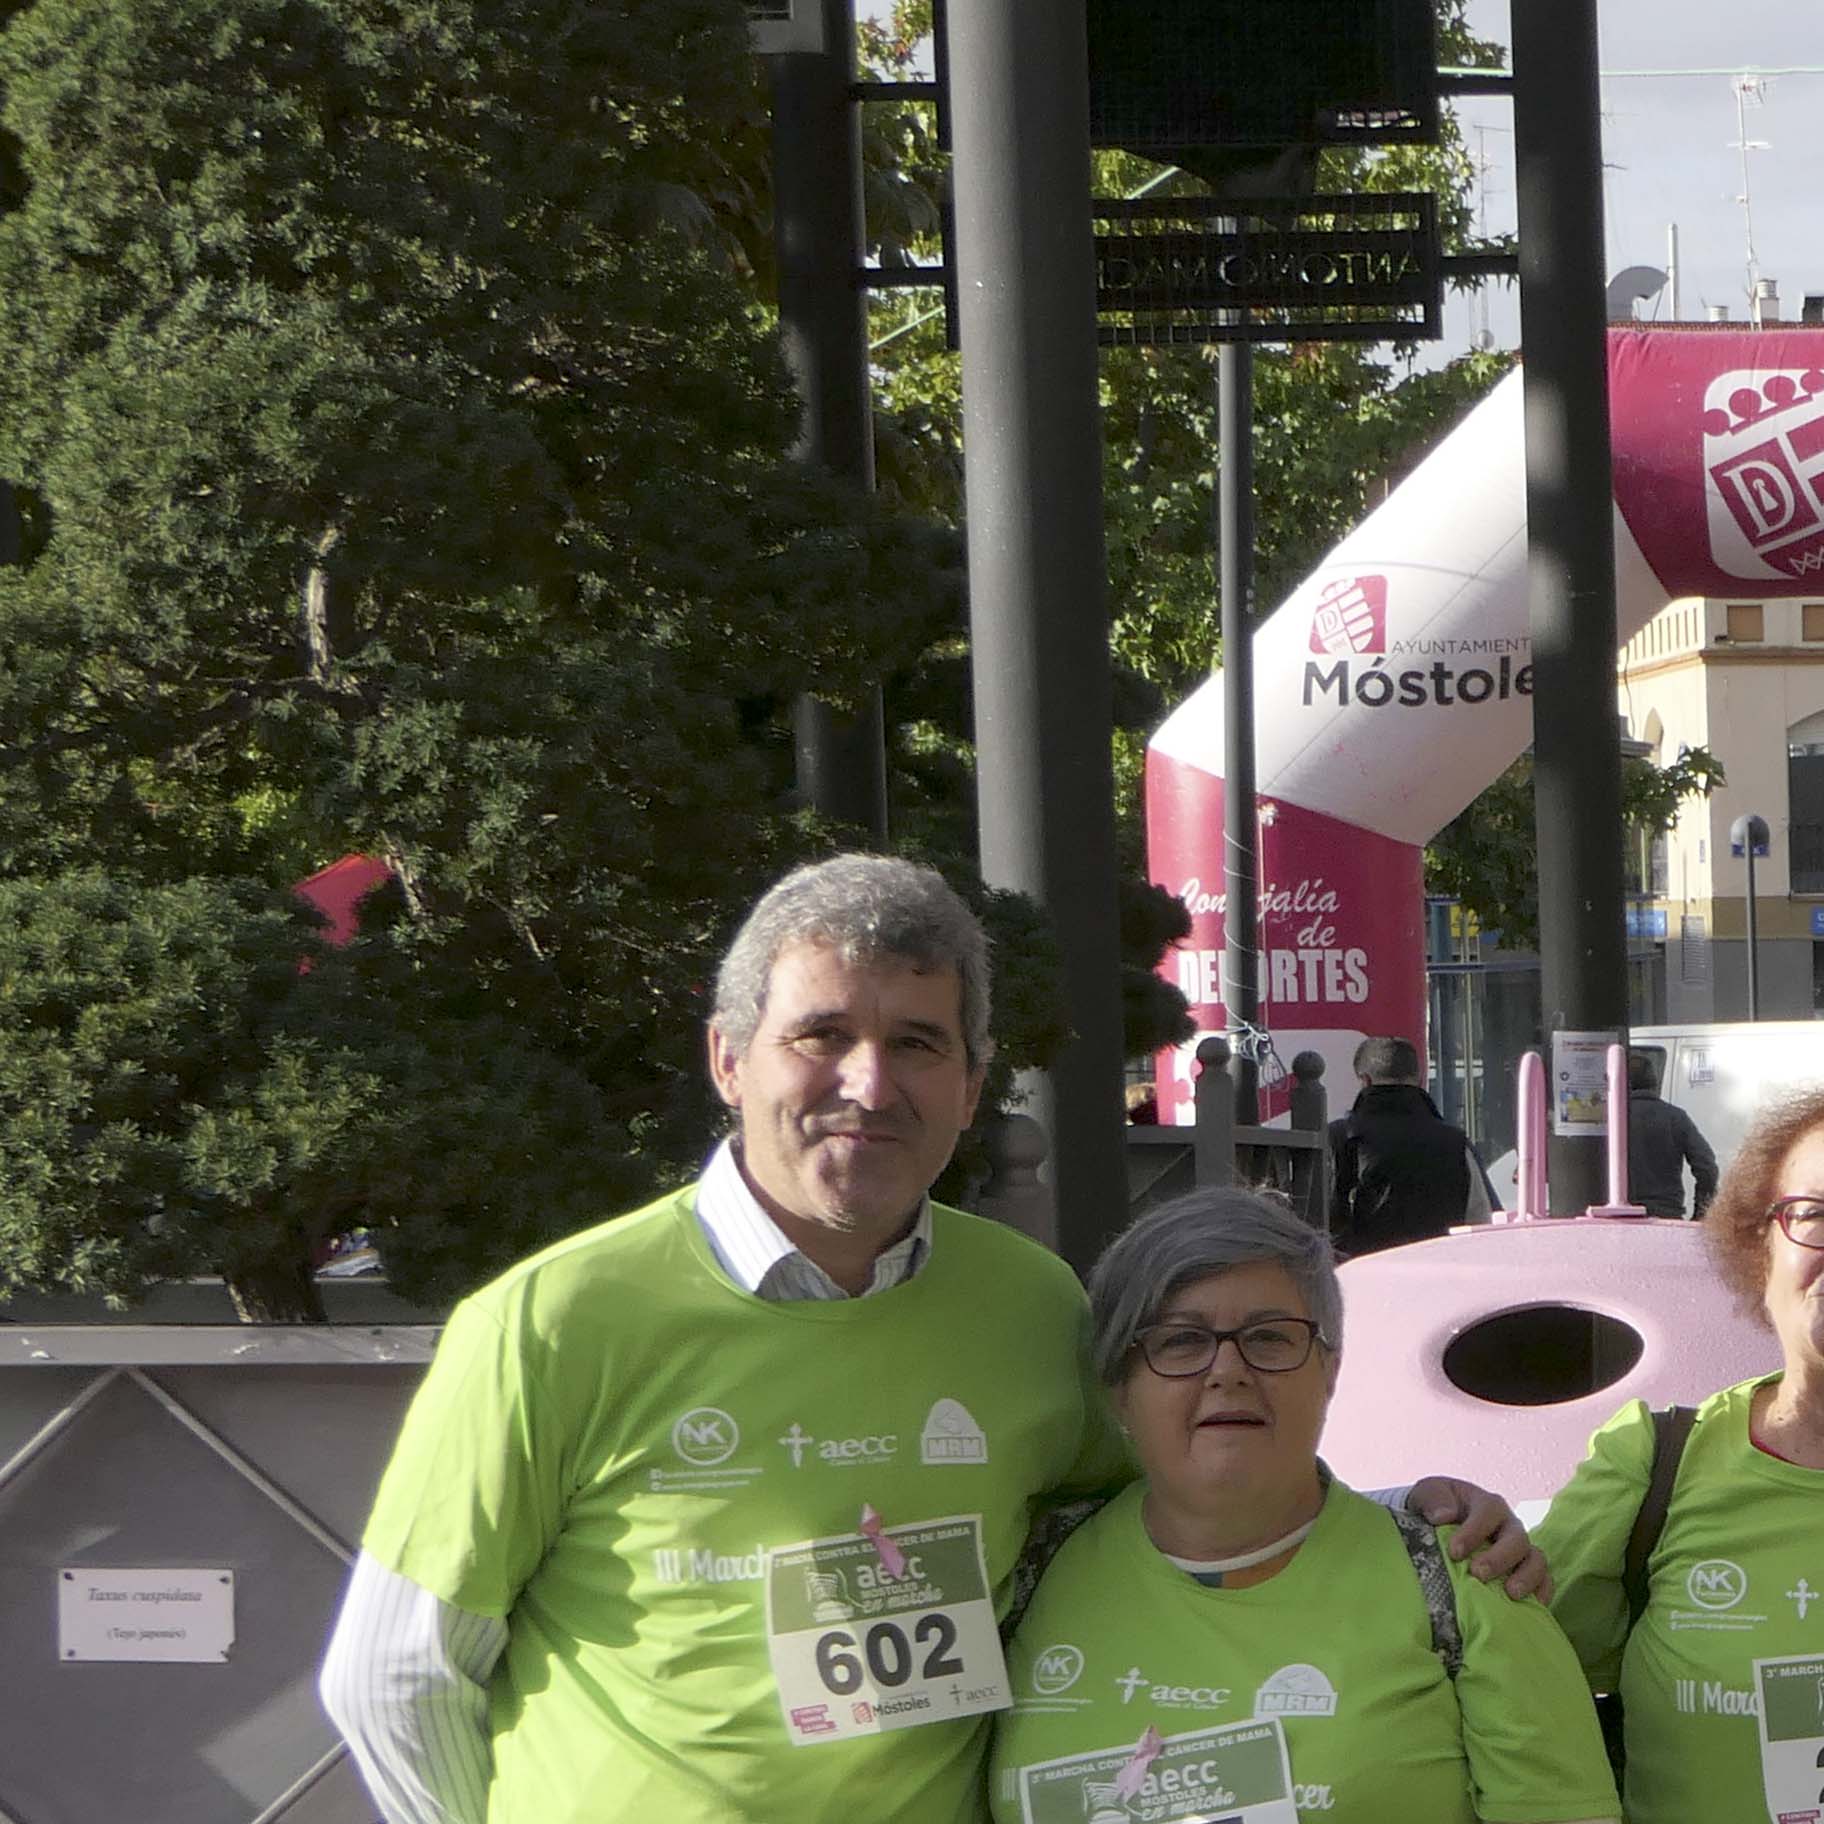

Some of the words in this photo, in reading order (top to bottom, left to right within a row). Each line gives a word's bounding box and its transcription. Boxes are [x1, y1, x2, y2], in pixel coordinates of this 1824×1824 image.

[1391, 636, 1532, 656] AYUNTAMIENT
[1302, 655, 1535, 708] Móstole
[1180, 877, 1341, 923] Conjalía
[1296, 915, 1337, 948] de
[818, 1434, 898, 1460] aecc
[927, 1437, 982, 1459] MRM
[937, 1526, 971, 1541] MAMA
[815, 1612, 965, 1697] 602
[873, 1695, 932, 1718] Móstoles
[1150, 1682, 1233, 1706] aecc
[1675, 1679, 1697, 1714] III
[1044, 1762, 1097, 1781] MARCHA
[1099, 1754, 1136, 1772] CONT
[1218, 1734, 1236, 1748] DE
[1237, 1726, 1274, 1744] MAMA
[1139, 1758, 1220, 1797] aecc
[1169, 1783, 1238, 1818] marcha
